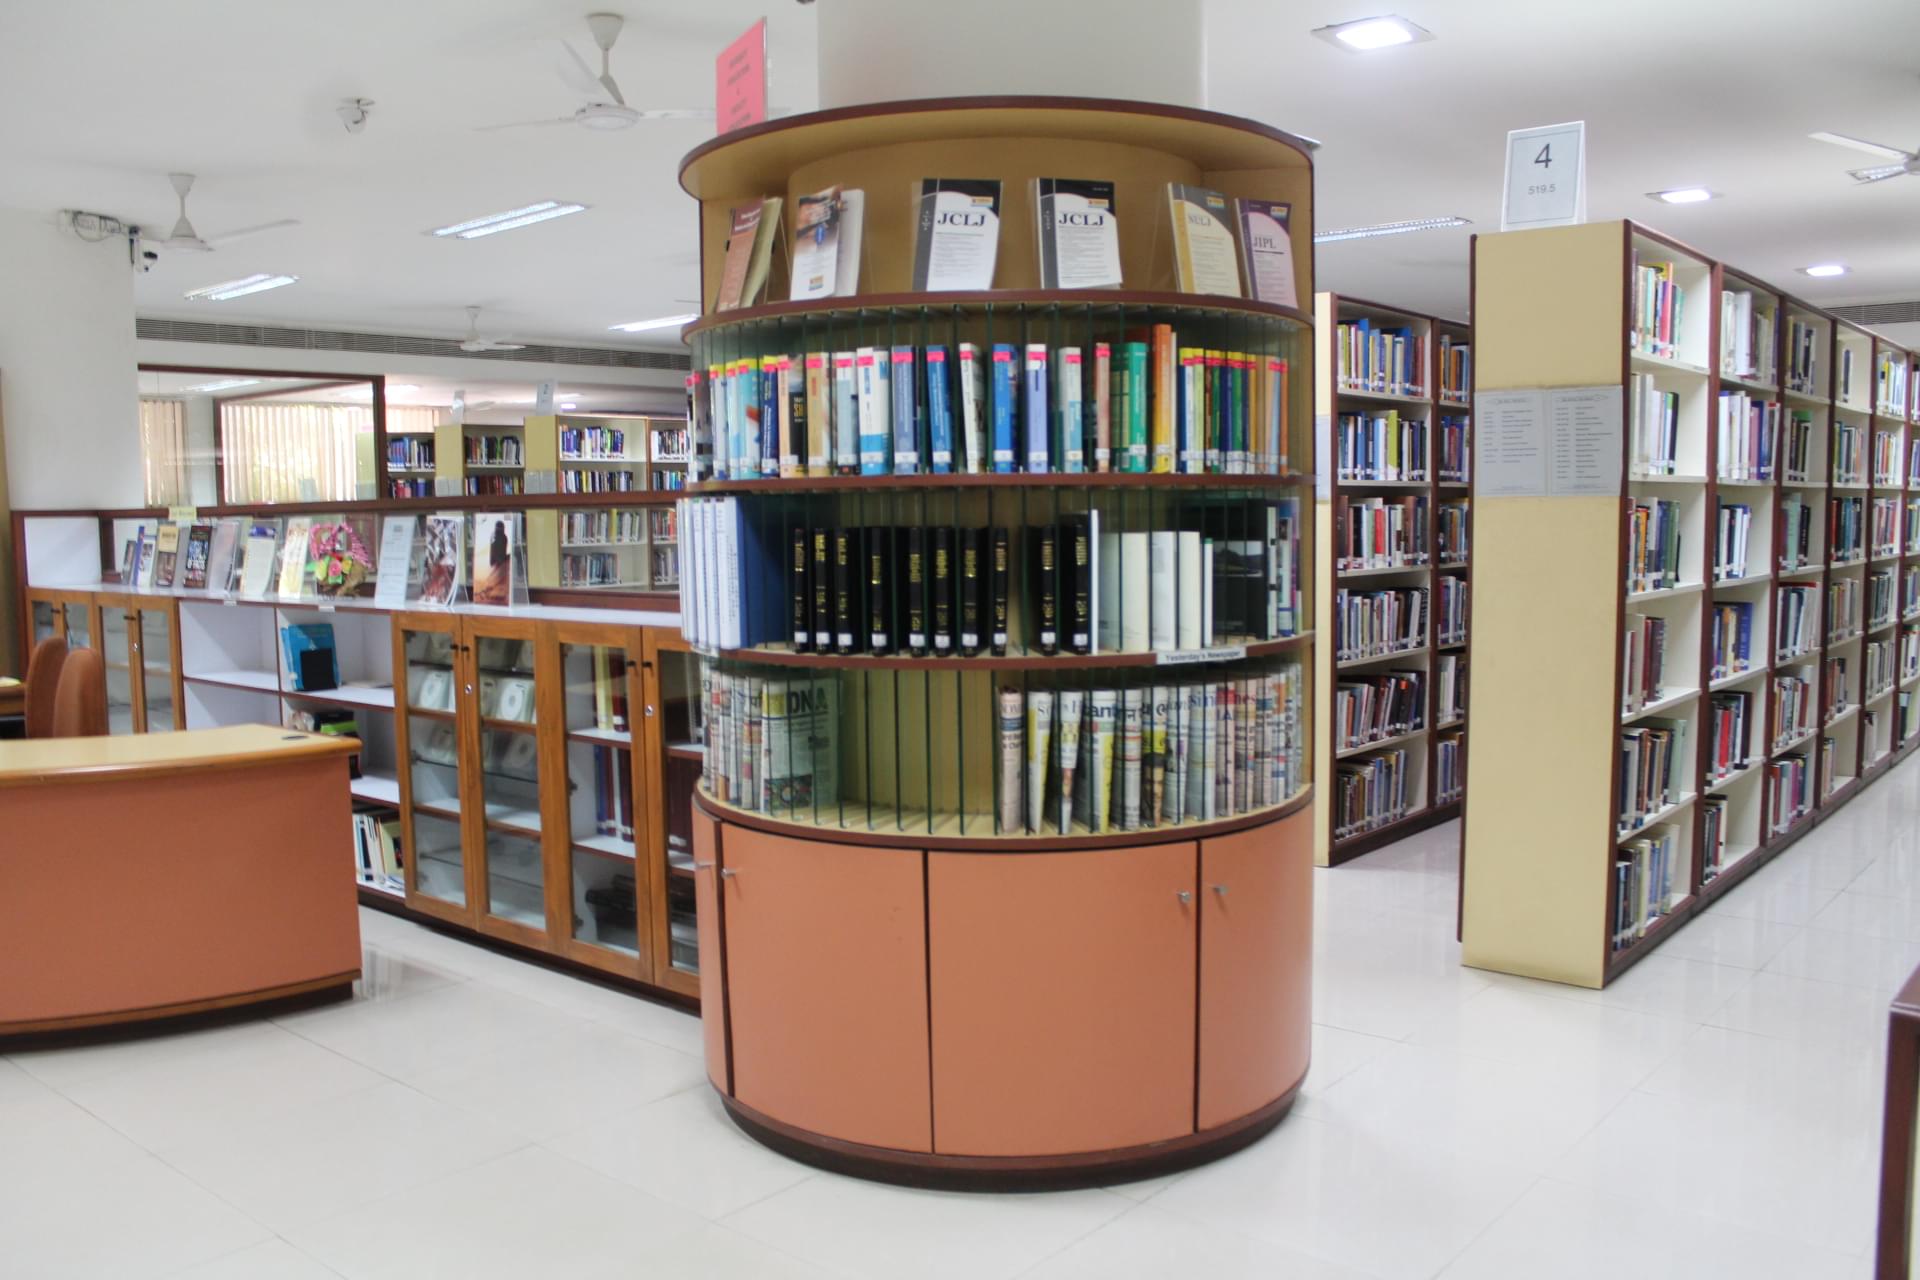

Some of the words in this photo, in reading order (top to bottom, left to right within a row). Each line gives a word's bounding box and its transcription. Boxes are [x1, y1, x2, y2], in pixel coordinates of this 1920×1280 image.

[1534, 142, 1552, 168] 4
[1528, 184, 1556, 195] 519.5
[937, 212, 986, 227] JCLJ
[1058, 212, 1105, 227] JCLJ
[788, 686, 829, 714] DNA
